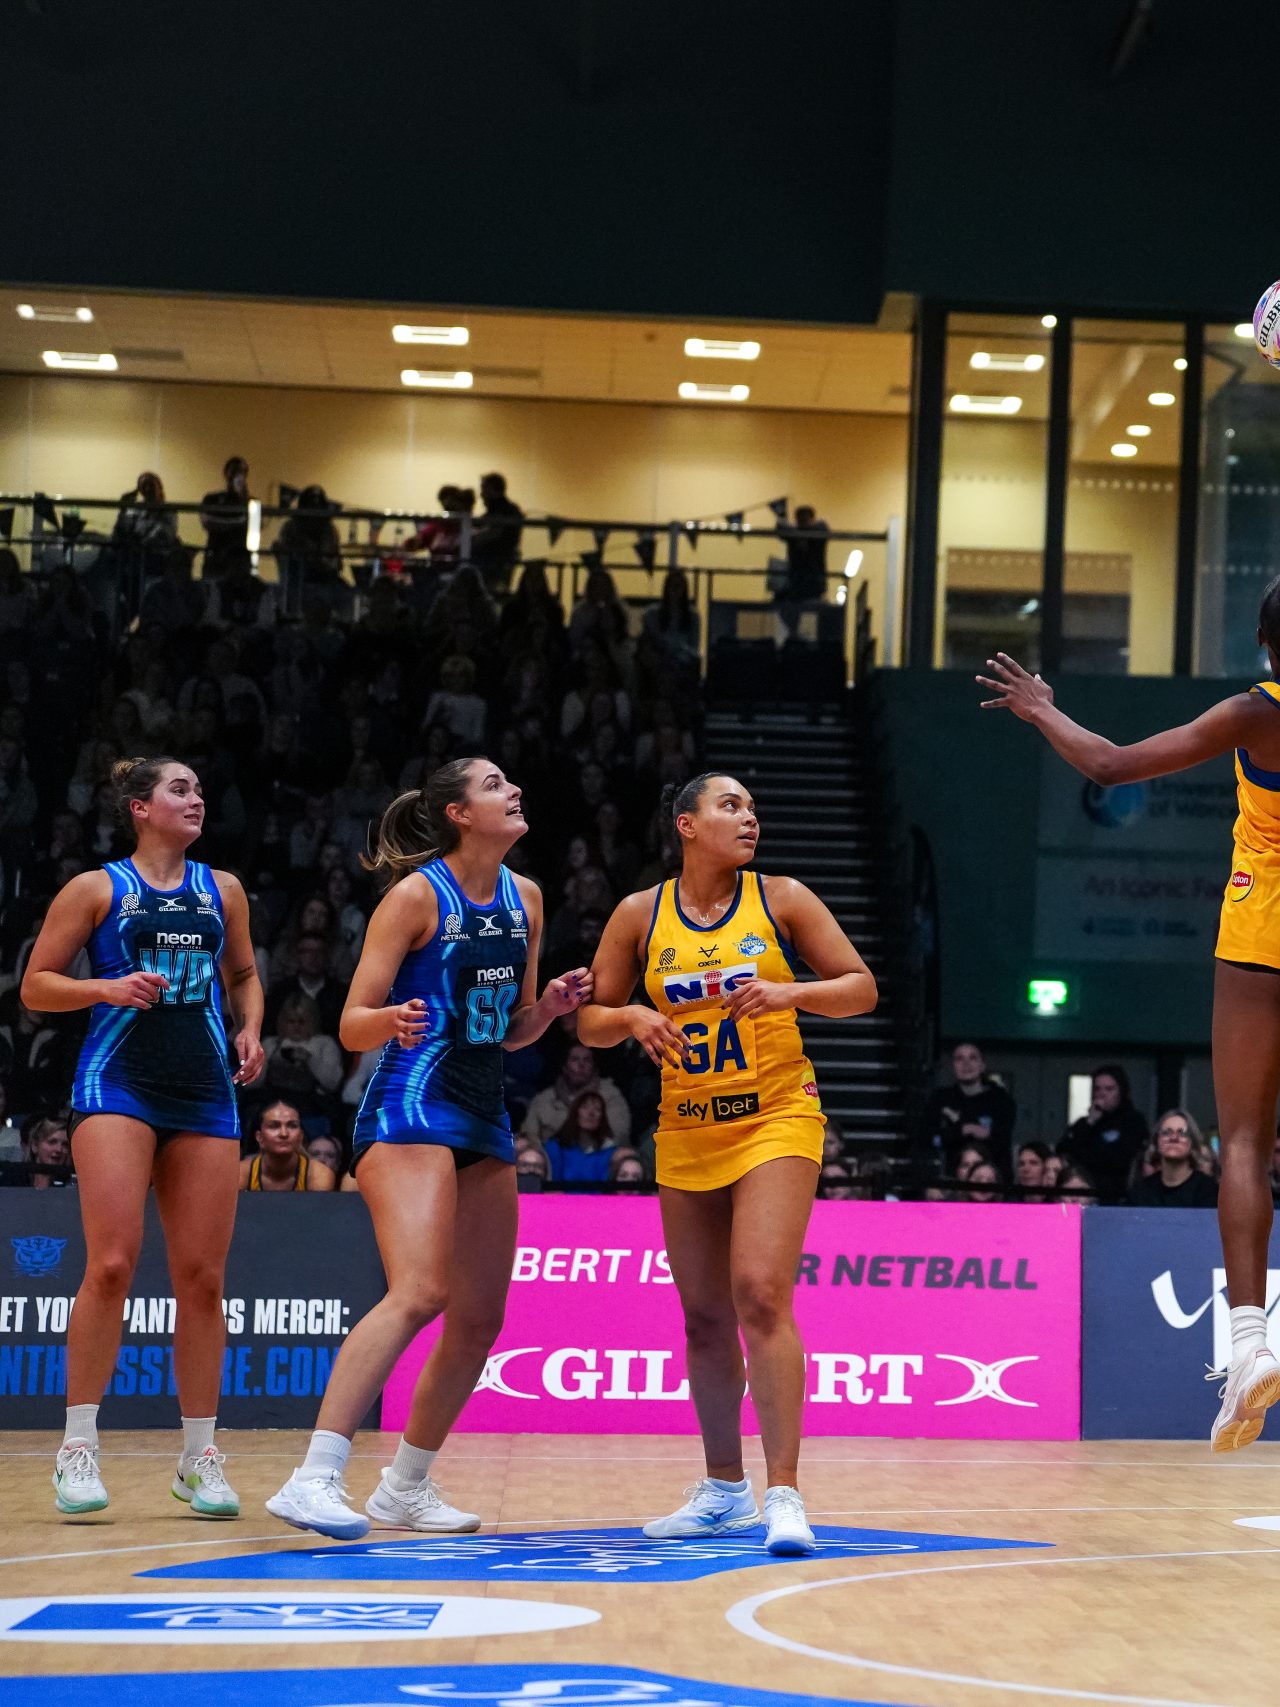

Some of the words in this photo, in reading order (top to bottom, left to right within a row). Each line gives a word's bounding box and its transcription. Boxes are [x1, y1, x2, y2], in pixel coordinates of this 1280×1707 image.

[116, 909, 148, 920] NETBALL
[156, 932, 202, 946] neon
[440, 933, 471, 941] NETBALL
[476, 965, 515, 982] neon
[653, 964, 682, 974] NETBALL
[697, 958, 722, 968] OXEN
[140, 949, 214, 1004] WD
[466, 981, 519, 1045] GD
[680, 1018, 748, 1075] GA
[677, 1098, 709, 1121] sky
[717, 1097, 754, 1117] bet
[511, 1247, 632, 1283] BERT
[639, 1250, 675, 1284] IS
[831, 1255, 1038, 1290] NETBALL
[0, 1296, 28, 1333] ET
[254, 1298, 350, 1335] MERCH:
[542, 1347, 923, 1405] GILRT
